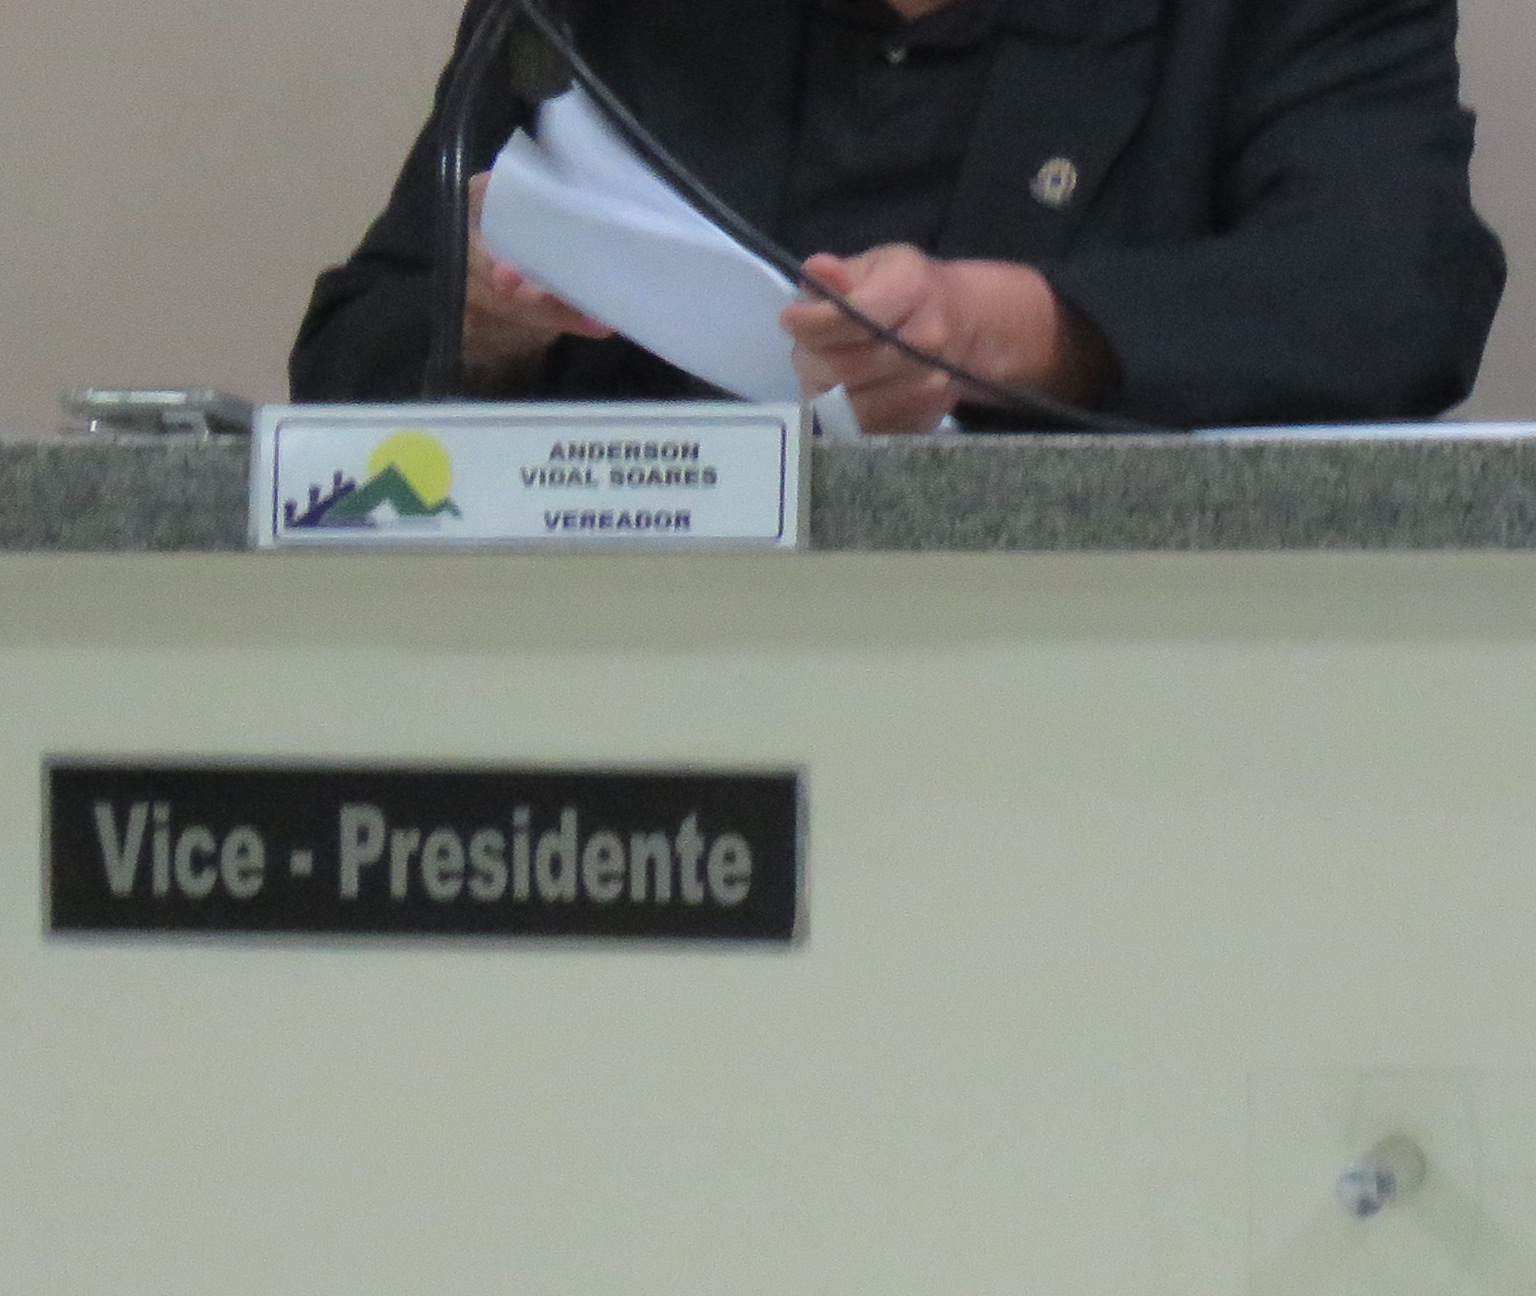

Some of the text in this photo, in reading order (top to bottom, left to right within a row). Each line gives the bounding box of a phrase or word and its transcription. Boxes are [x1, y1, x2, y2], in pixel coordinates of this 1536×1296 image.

[549, 440, 700, 461] ANDERSON
[520, 466, 718, 488] VIDAL SOARES
[544, 510, 692, 532] VEREADOR
[95, 803, 754, 904] Vice - Presidente
